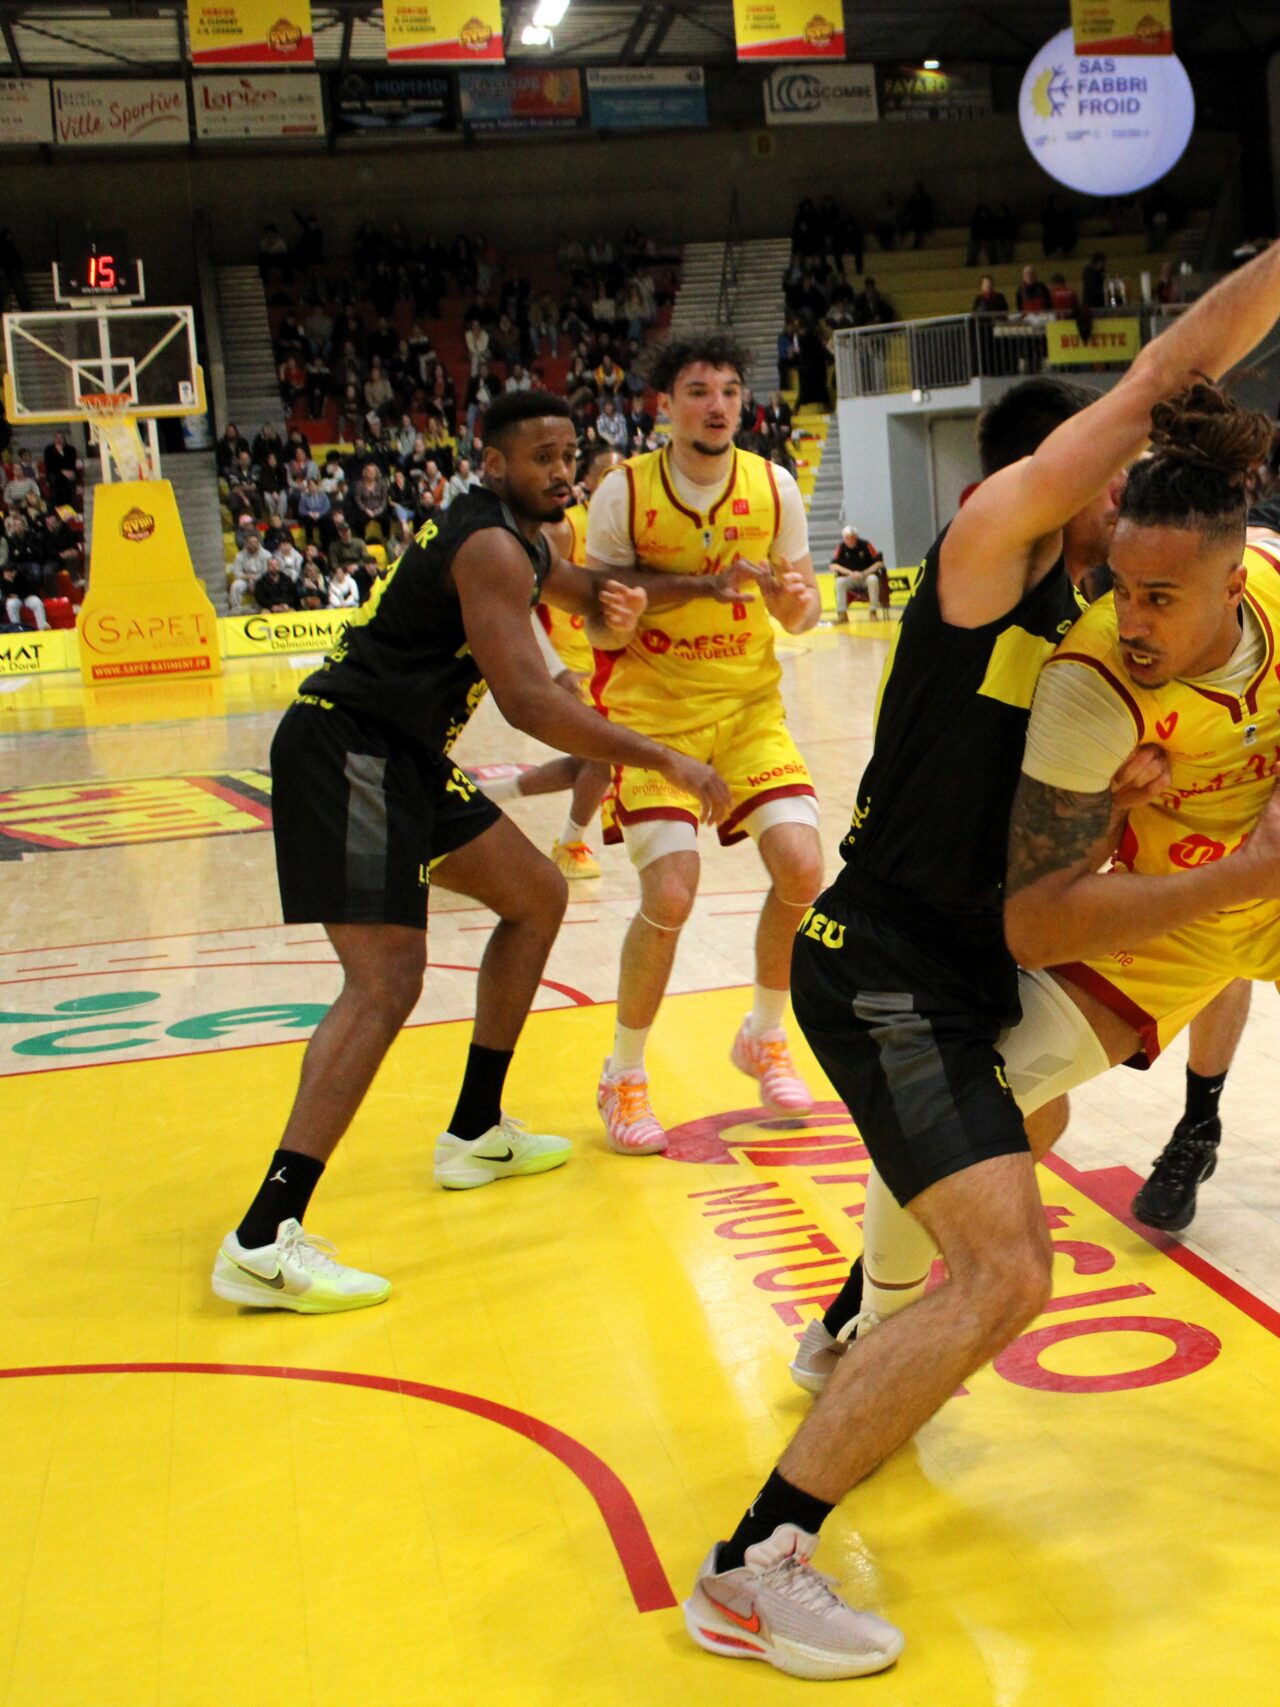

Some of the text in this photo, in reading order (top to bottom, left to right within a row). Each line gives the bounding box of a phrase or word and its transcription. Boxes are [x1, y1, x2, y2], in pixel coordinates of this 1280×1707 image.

[1078, 59, 1116, 74] SAS
[1077, 77, 1148, 94] FABBRI
[1078, 98, 1141, 114] FROID
[60, 112, 101, 141] Ville
[109, 91, 183, 131] Sportive
[90, 256, 115, 288] 15
[1061, 333, 1127, 348] BUETTE
[98, 613, 206, 643] SAPET
